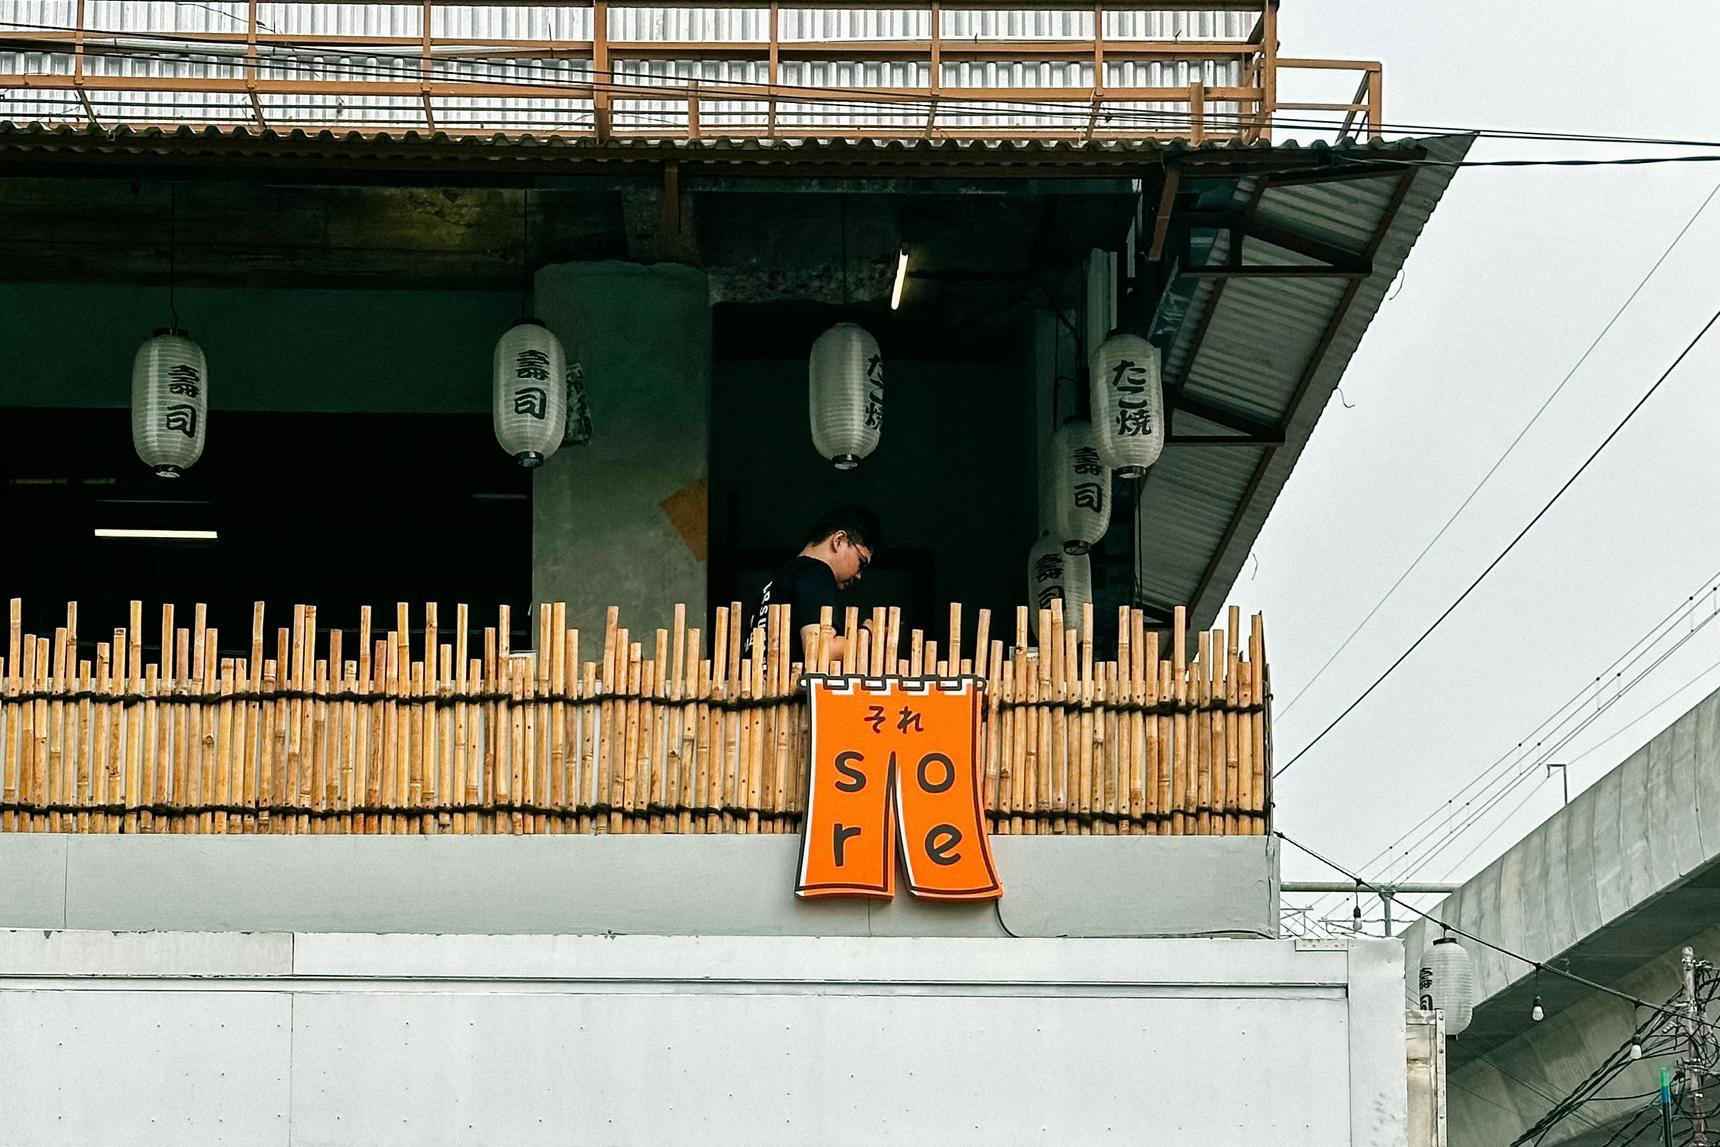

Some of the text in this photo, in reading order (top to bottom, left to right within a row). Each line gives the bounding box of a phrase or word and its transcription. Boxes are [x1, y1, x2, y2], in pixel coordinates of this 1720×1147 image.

[1112, 360, 1152, 436] たこ焼
[863, 705, 924, 734] それ
